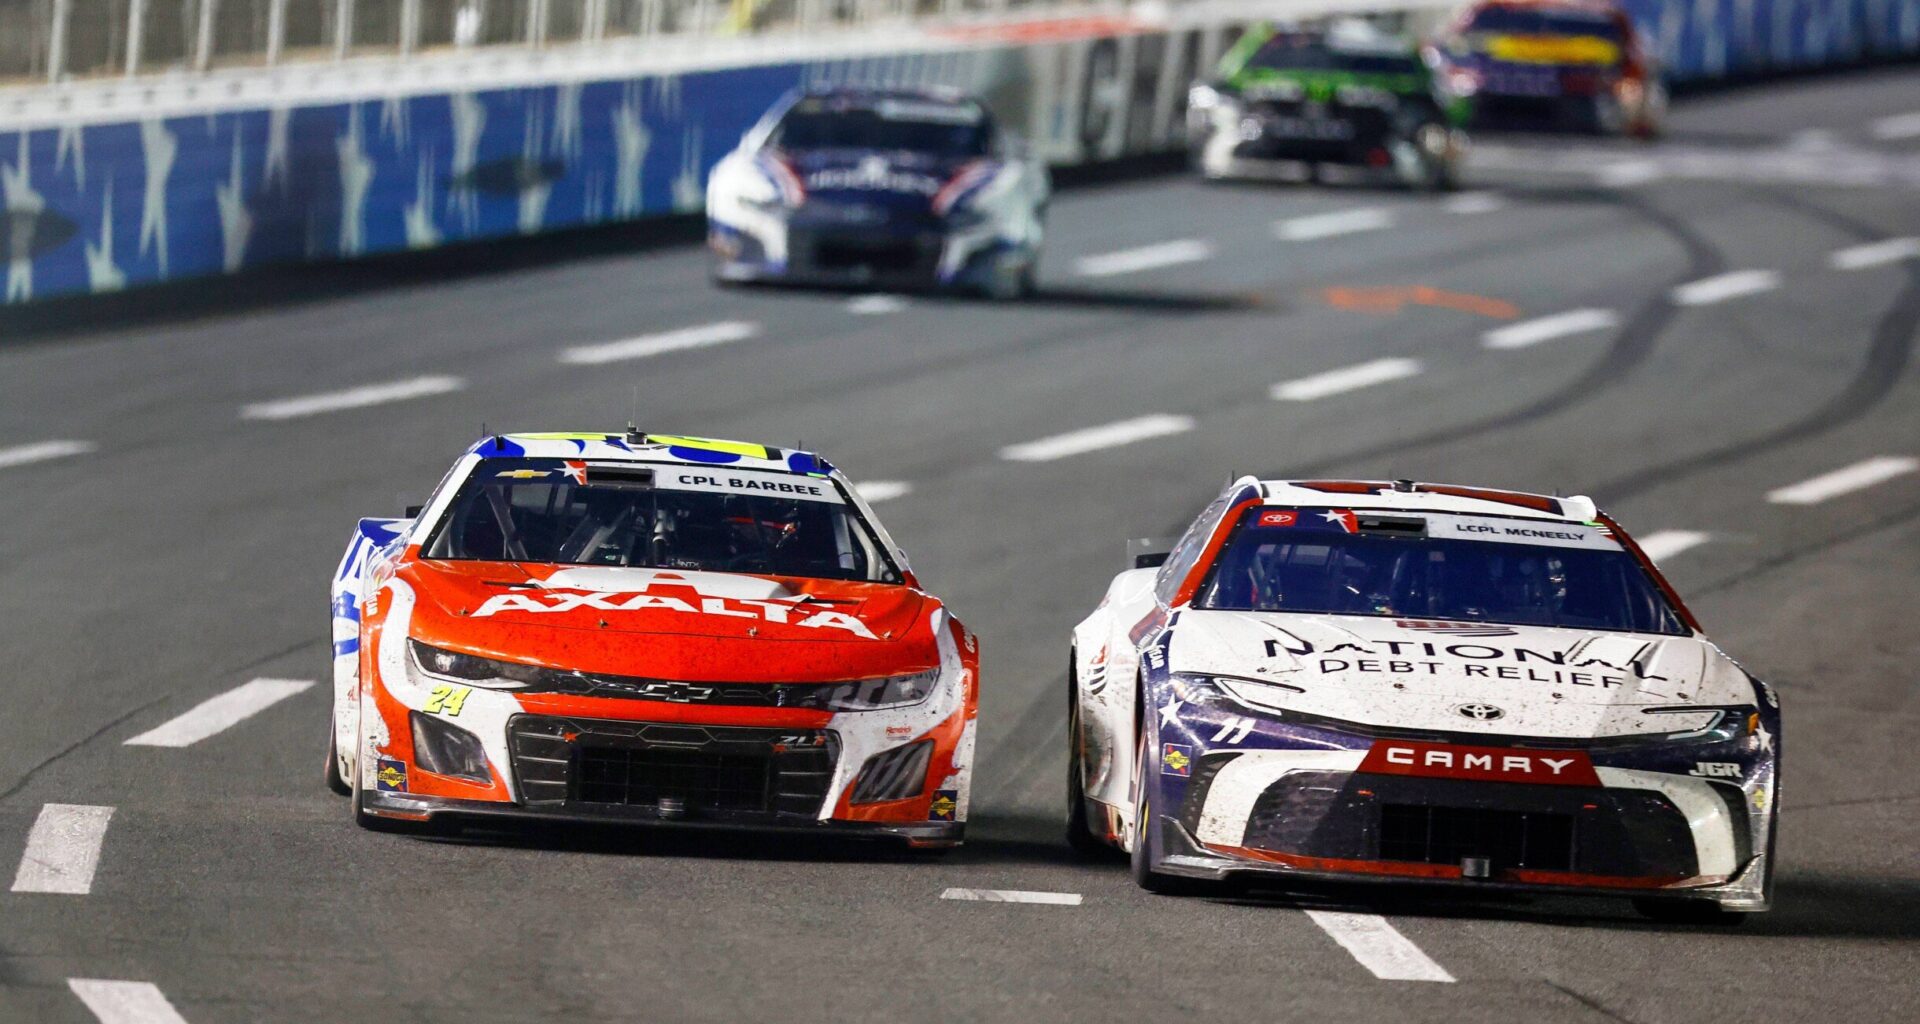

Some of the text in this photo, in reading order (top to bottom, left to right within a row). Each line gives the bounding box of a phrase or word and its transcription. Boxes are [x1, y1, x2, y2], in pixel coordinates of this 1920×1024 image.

[678, 475, 822, 496] CPL BARBEE
[1456, 524, 1585, 541] LCPL MCNEELY
[470, 592, 880, 640] AXALTA
[1263, 639, 1668, 682] NATIONAL
[1319, 657, 1627, 689] DEBT RELIEF
[423, 684, 472, 716] 24
[1386, 746, 1575, 775] CAMRY
[1688, 761, 1744, 777] JGR
